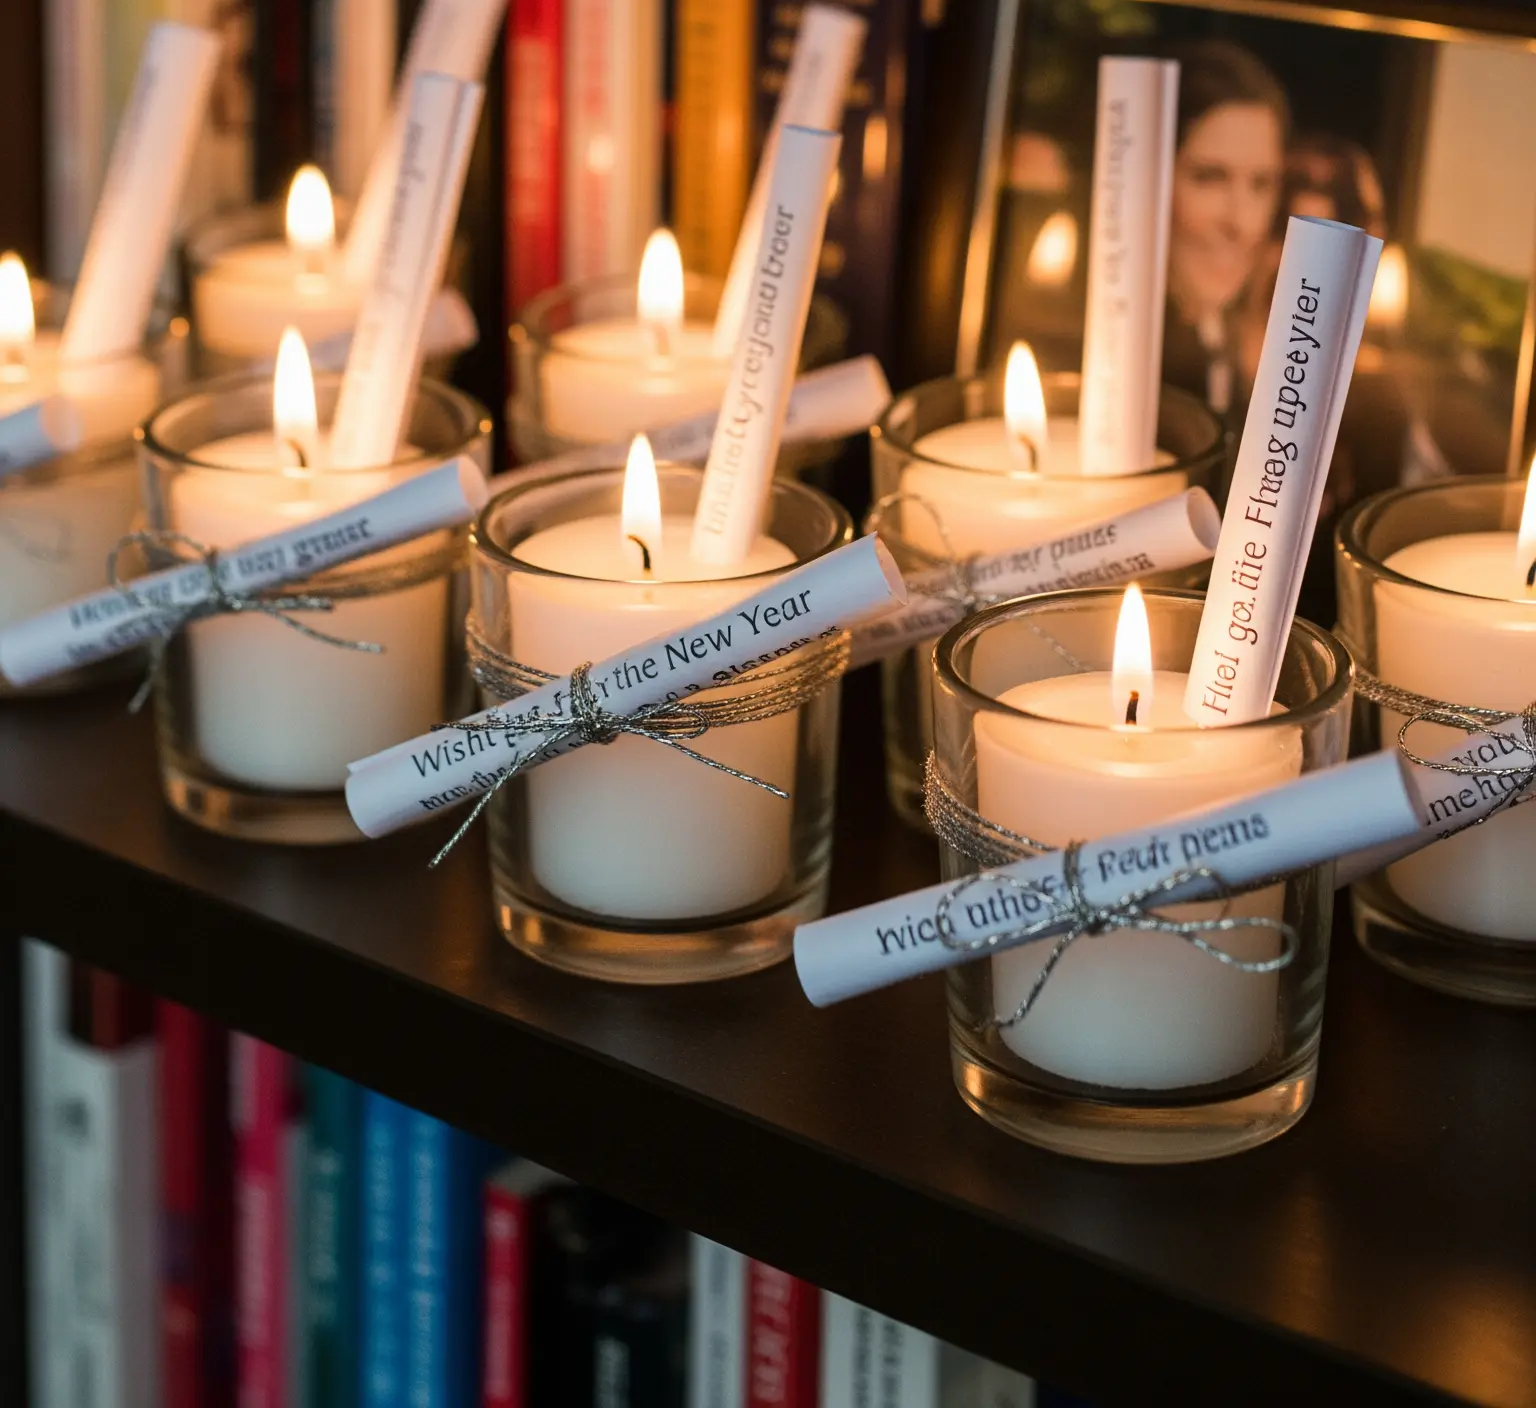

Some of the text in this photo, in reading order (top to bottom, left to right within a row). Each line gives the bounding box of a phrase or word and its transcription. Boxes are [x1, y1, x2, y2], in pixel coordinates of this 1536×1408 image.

[611, 654, 661, 692] the
[665, 624, 735, 673] New
[738, 588, 813, 636] Year
